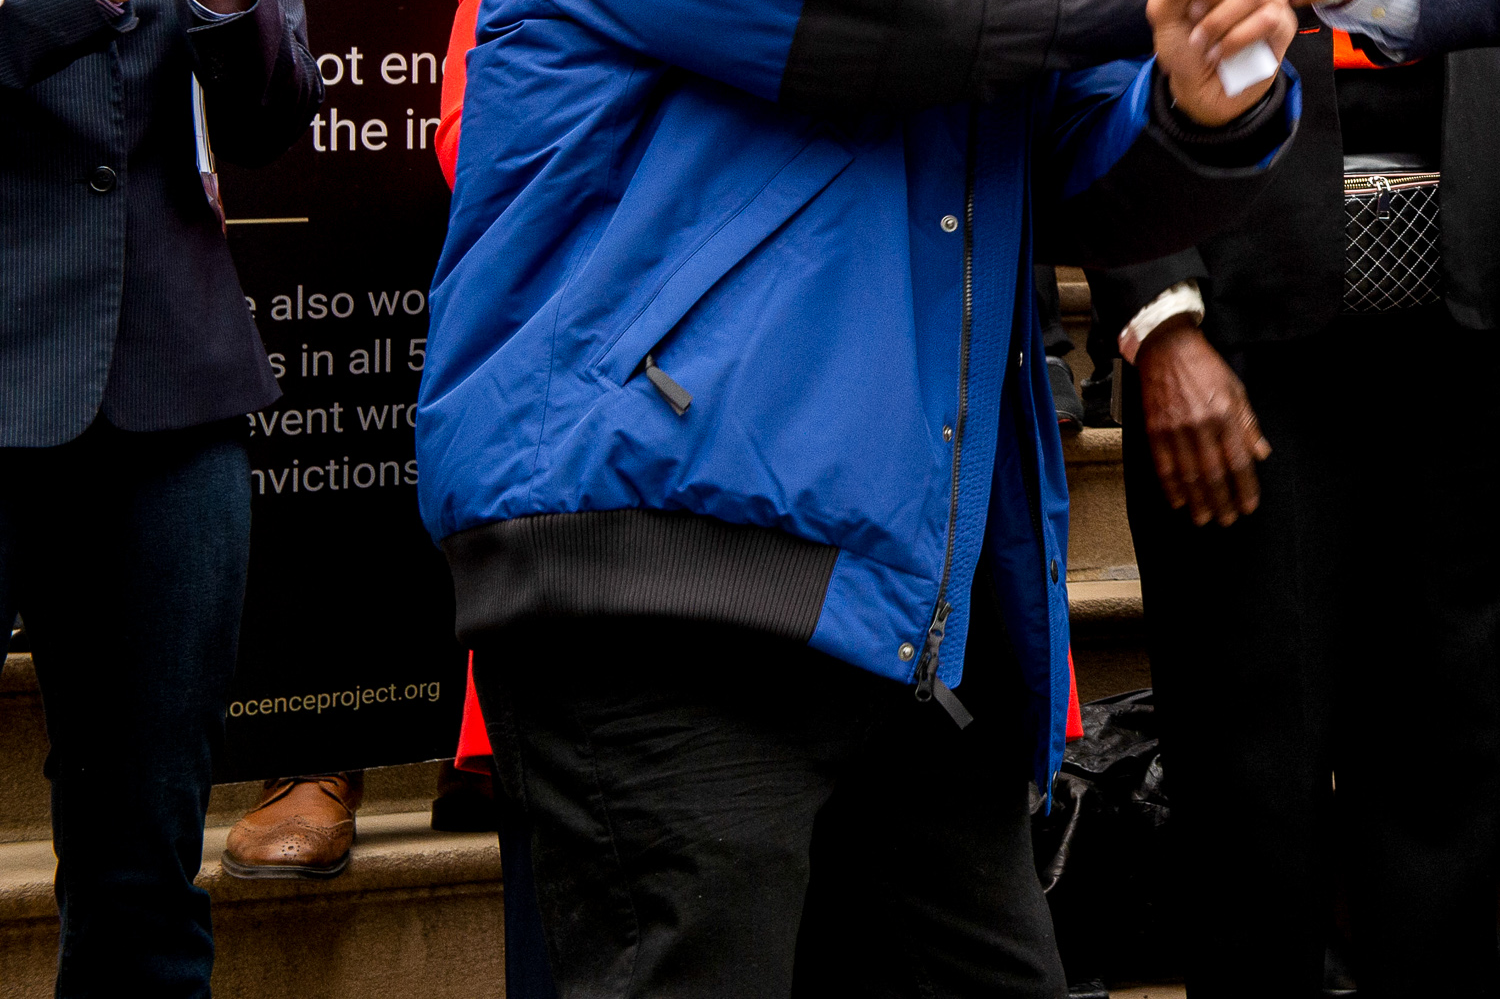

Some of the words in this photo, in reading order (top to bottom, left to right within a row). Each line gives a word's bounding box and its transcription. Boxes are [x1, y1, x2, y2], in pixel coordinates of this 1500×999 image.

[381, 52, 446, 85] en
[311, 108, 388, 152] the
[271, 285, 354, 321] also
[302, 343, 333, 377] in
[349, 338, 391, 375] all
[226, 682, 440, 718] ocenceproject.org
